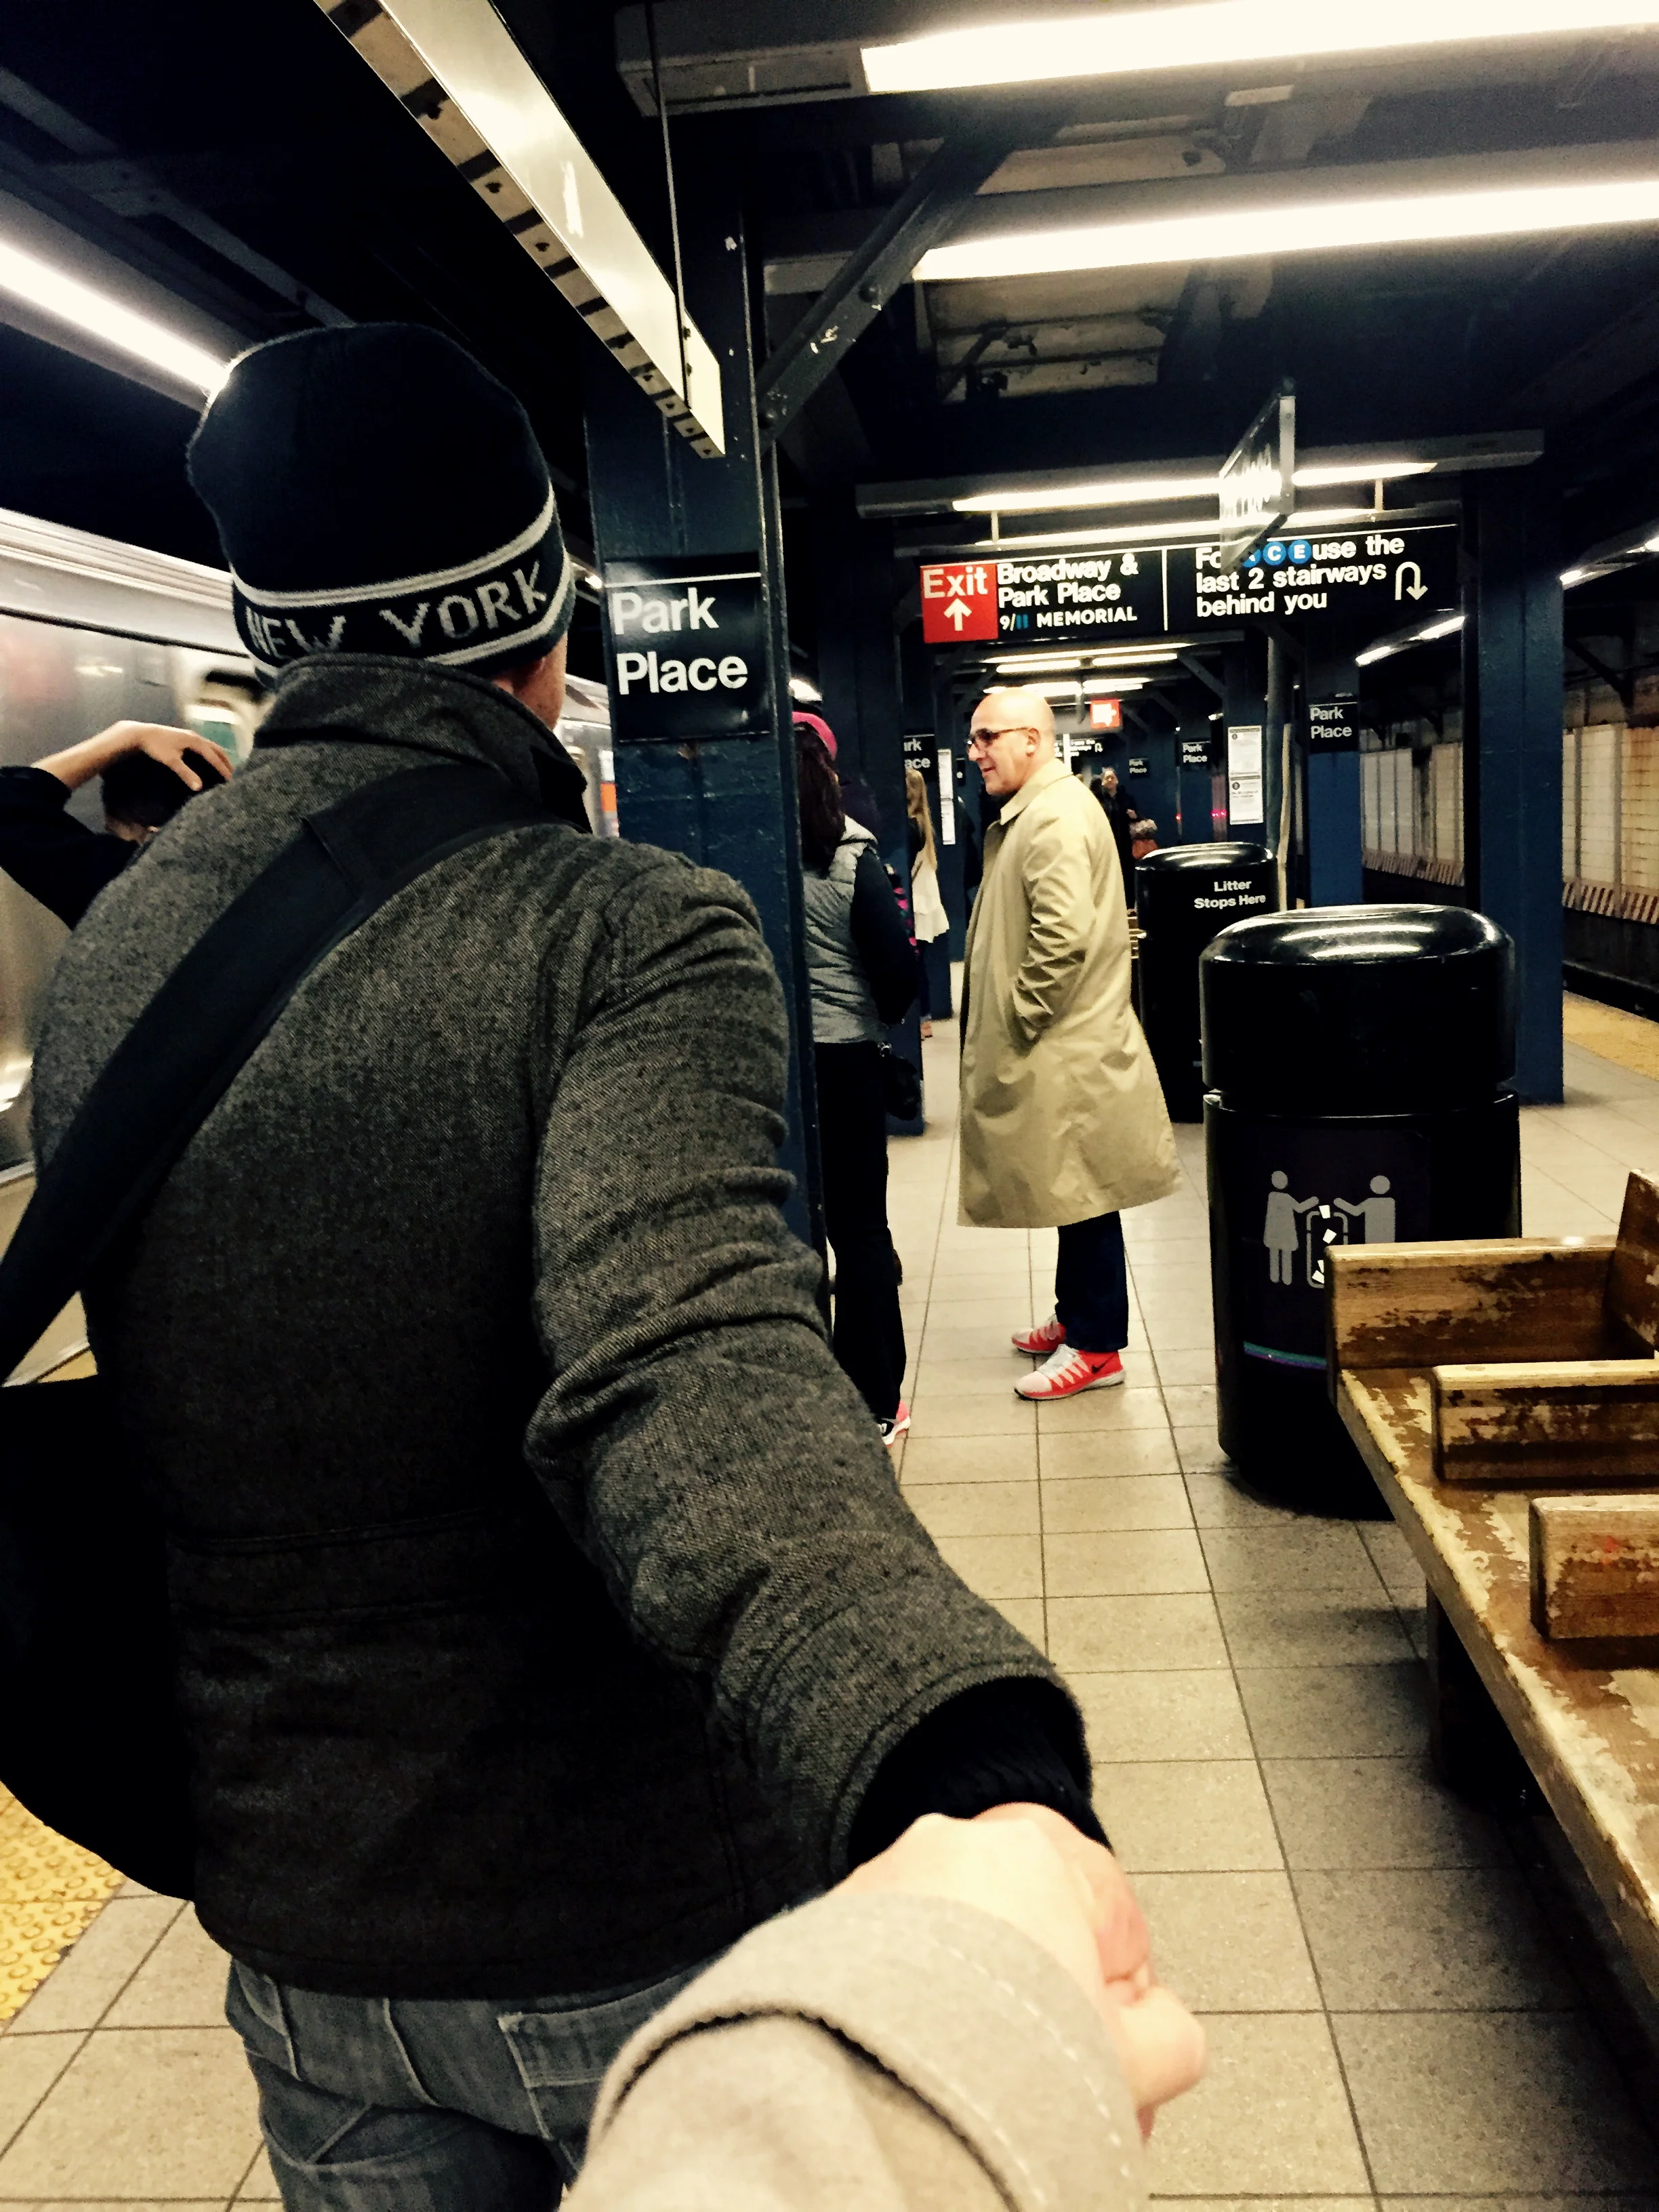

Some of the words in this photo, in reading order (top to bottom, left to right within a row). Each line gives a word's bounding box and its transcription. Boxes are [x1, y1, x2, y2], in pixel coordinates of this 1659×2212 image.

[1313, 540, 1356, 560] use
[1366, 534, 1405, 556] the
[997, 558, 1111, 585] Broadway
[1120, 552, 1139, 575] &
[1196, 571, 1240, 594] last
[1248, 568, 1264, 590] 2
[1273, 563, 1387, 586] stairways
[922, 566, 988, 598] Exit
[998, 587, 1049, 609] Park
[1057, 581, 1120, 605] Place
[1196, 591, 1275, 617] behind
[1284, 592, 1327, 615] you
[246, 606, 346, 659] NEW
[379, 560, 547, 648] YORK
[612, 587, 719, 635] Park
[1000, 613, 1029, 631] 9/11
[1036, 606, 1138, 628] MEMORIAL
[617, 651, 747, 695] Place
[1310, 706, 1344, 721] Park
[1311, 725, 1352, 739] Place
[904, 739, 922, 751] rk
[1183, 743, 1203, 753] Park
[904, 758, 931, 769] ace
[1183, 755, 1208, 763] Place
[1214, 880, 1252, 892] Litter
[1194, 898, 1236, 909] Stops
[1239, 895, 1266, 905] Here
